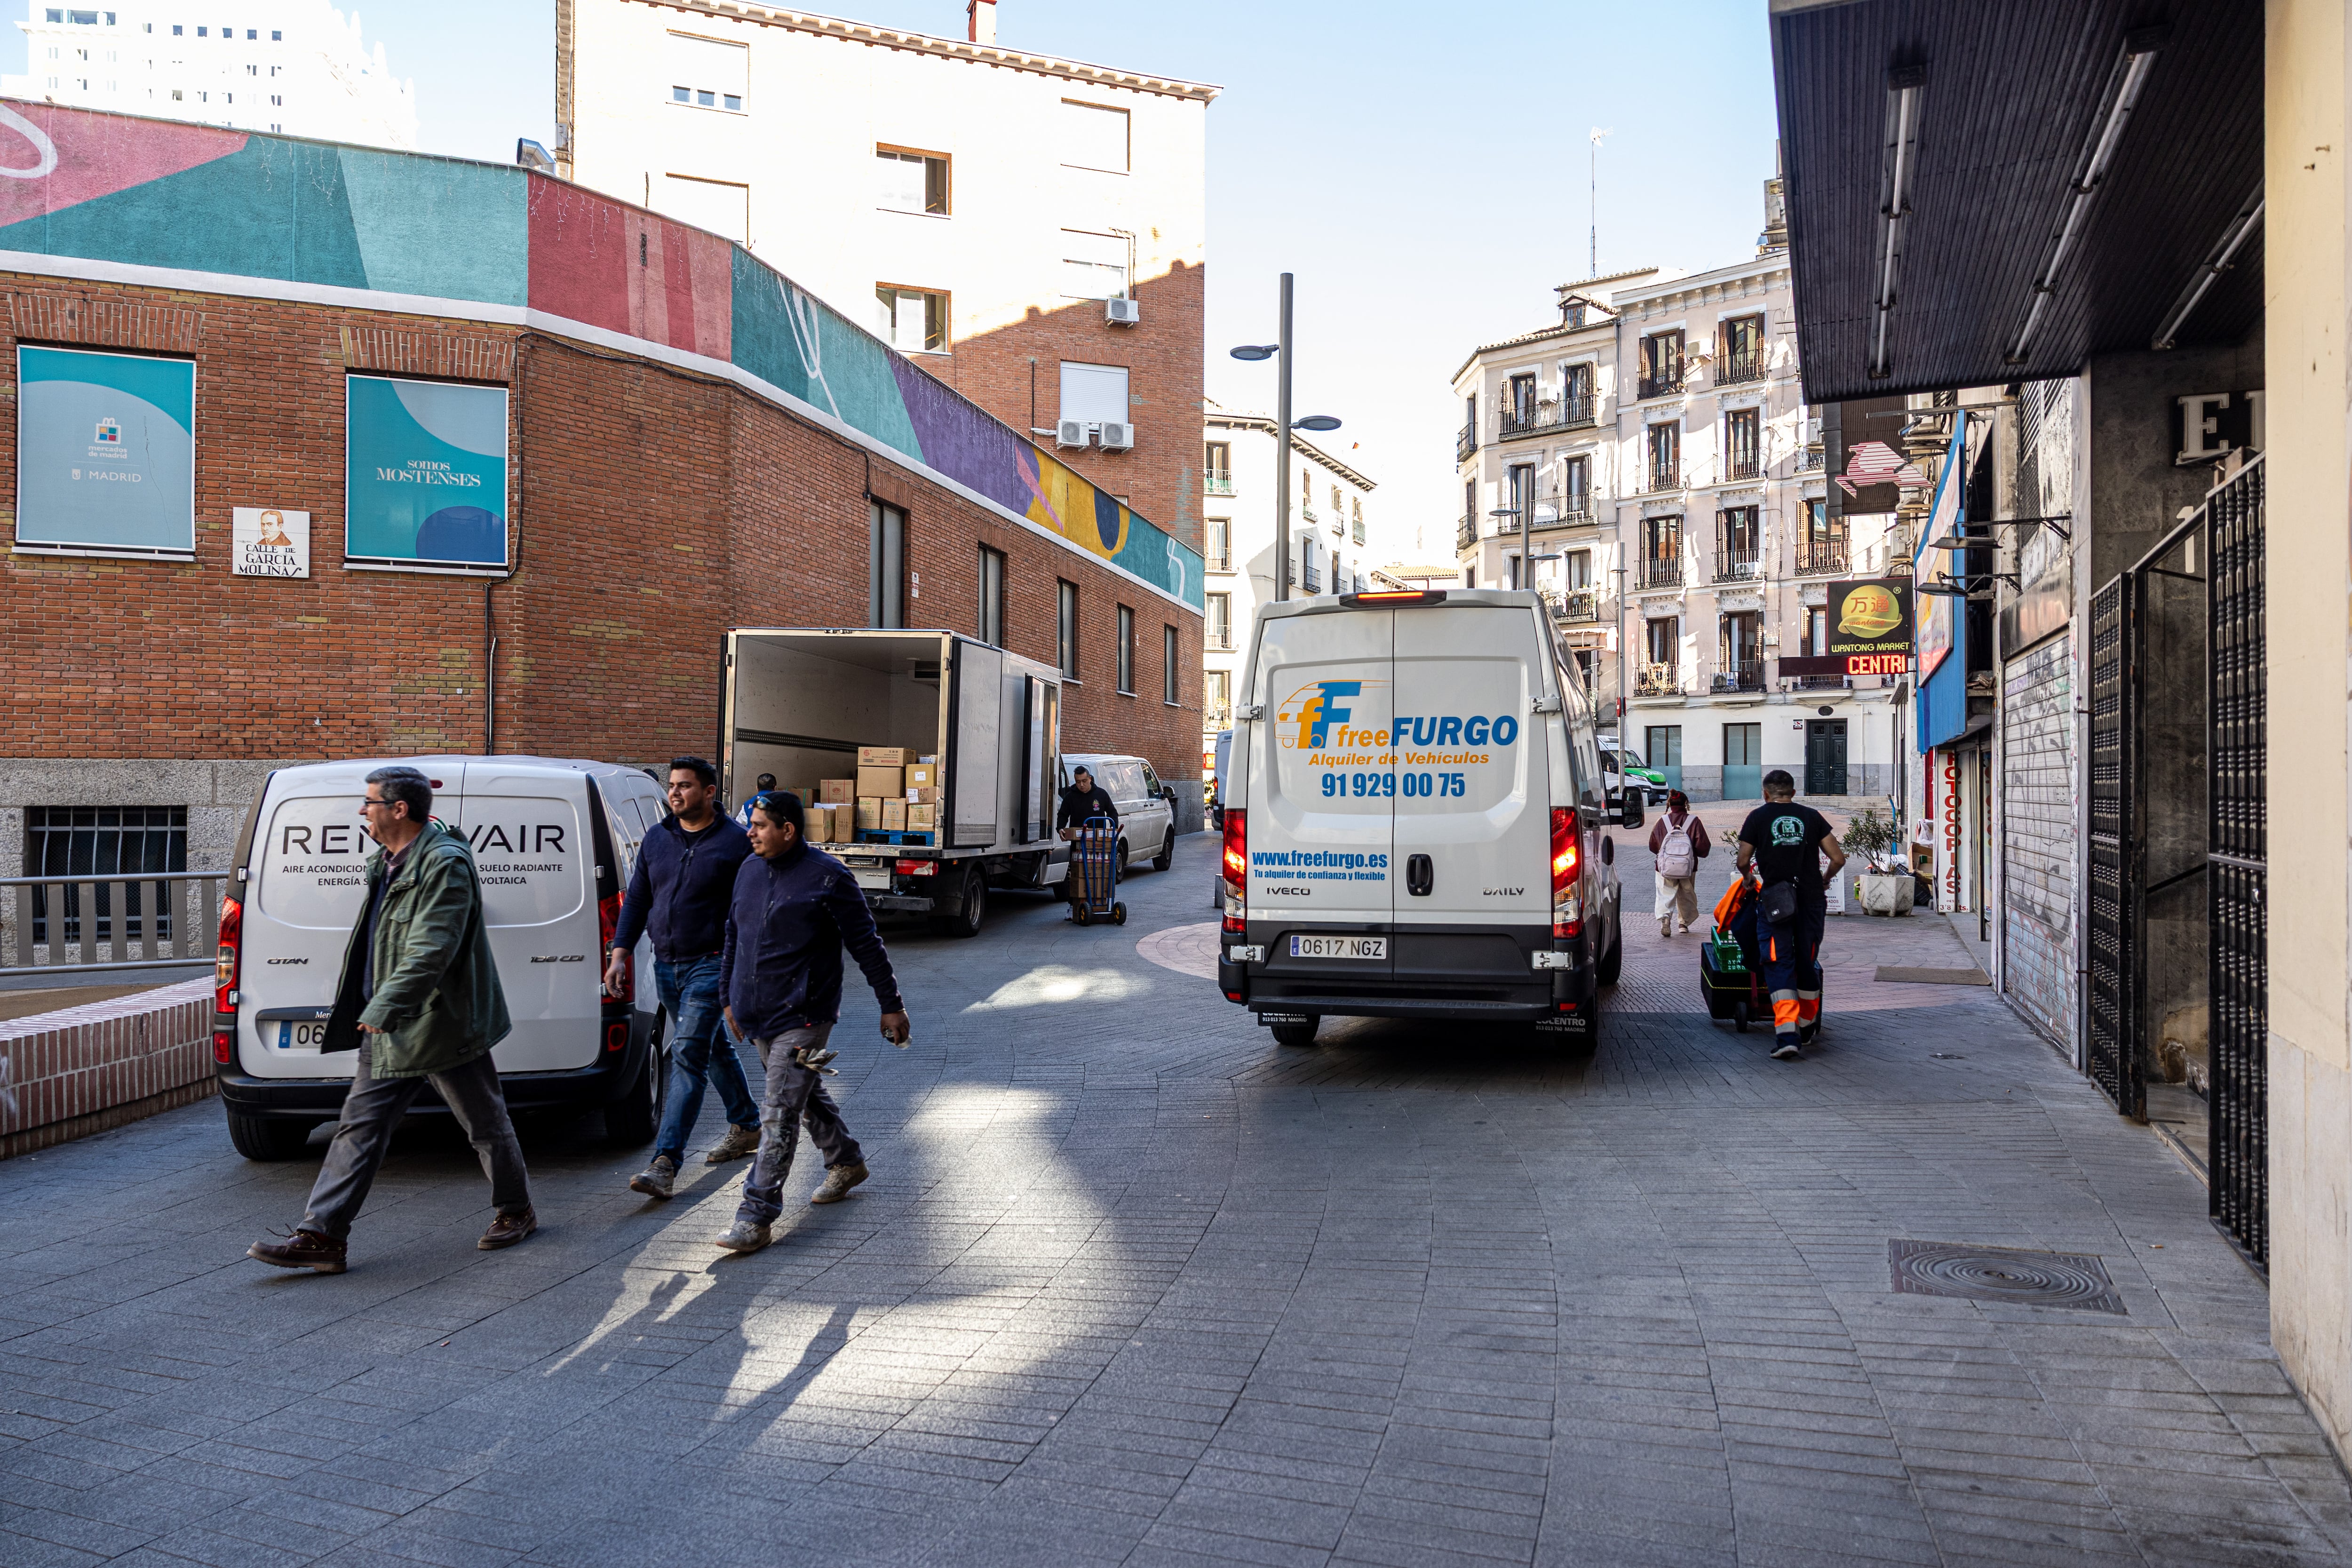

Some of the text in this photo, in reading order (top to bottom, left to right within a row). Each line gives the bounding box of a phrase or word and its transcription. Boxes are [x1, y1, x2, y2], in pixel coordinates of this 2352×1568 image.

[407, 460, 450, 471] somos
[89, 470, 142, 482] MADRID
[376, 467, 481, 487] MOSTENSES
[246, 544, 278, 553] CALLE
[246, 553, 297, 565] GARCÍA
[238, 564, 302, 577] MOLINAS
[1851, 595, 1889, 613] 万通
[1831, 642, 1910, 653] WANTONG MARKET
[1337, 715, 1518, 747] freeFURGO
[1308, 752, 1489, 768] Alquiler de Vehículos
[1322, 773, 1465, 797] 91 929 00 75
[1252, 850, 1388, 869] www.freefurgo.es
[318, 876, 360, 885] ENERGÍA
[1264, 870, 1295, 879] alquiler
[1308, 871, 1346, 879] confianza
[1354, 872, 1385, 880] flexible
[1267, 886, 1311, 895] IVECO
[1303, 939, 1343, 955] 0617
[1350, 940, 1383, 956] NGZ
[297, 1025, 325, 1044] 06
